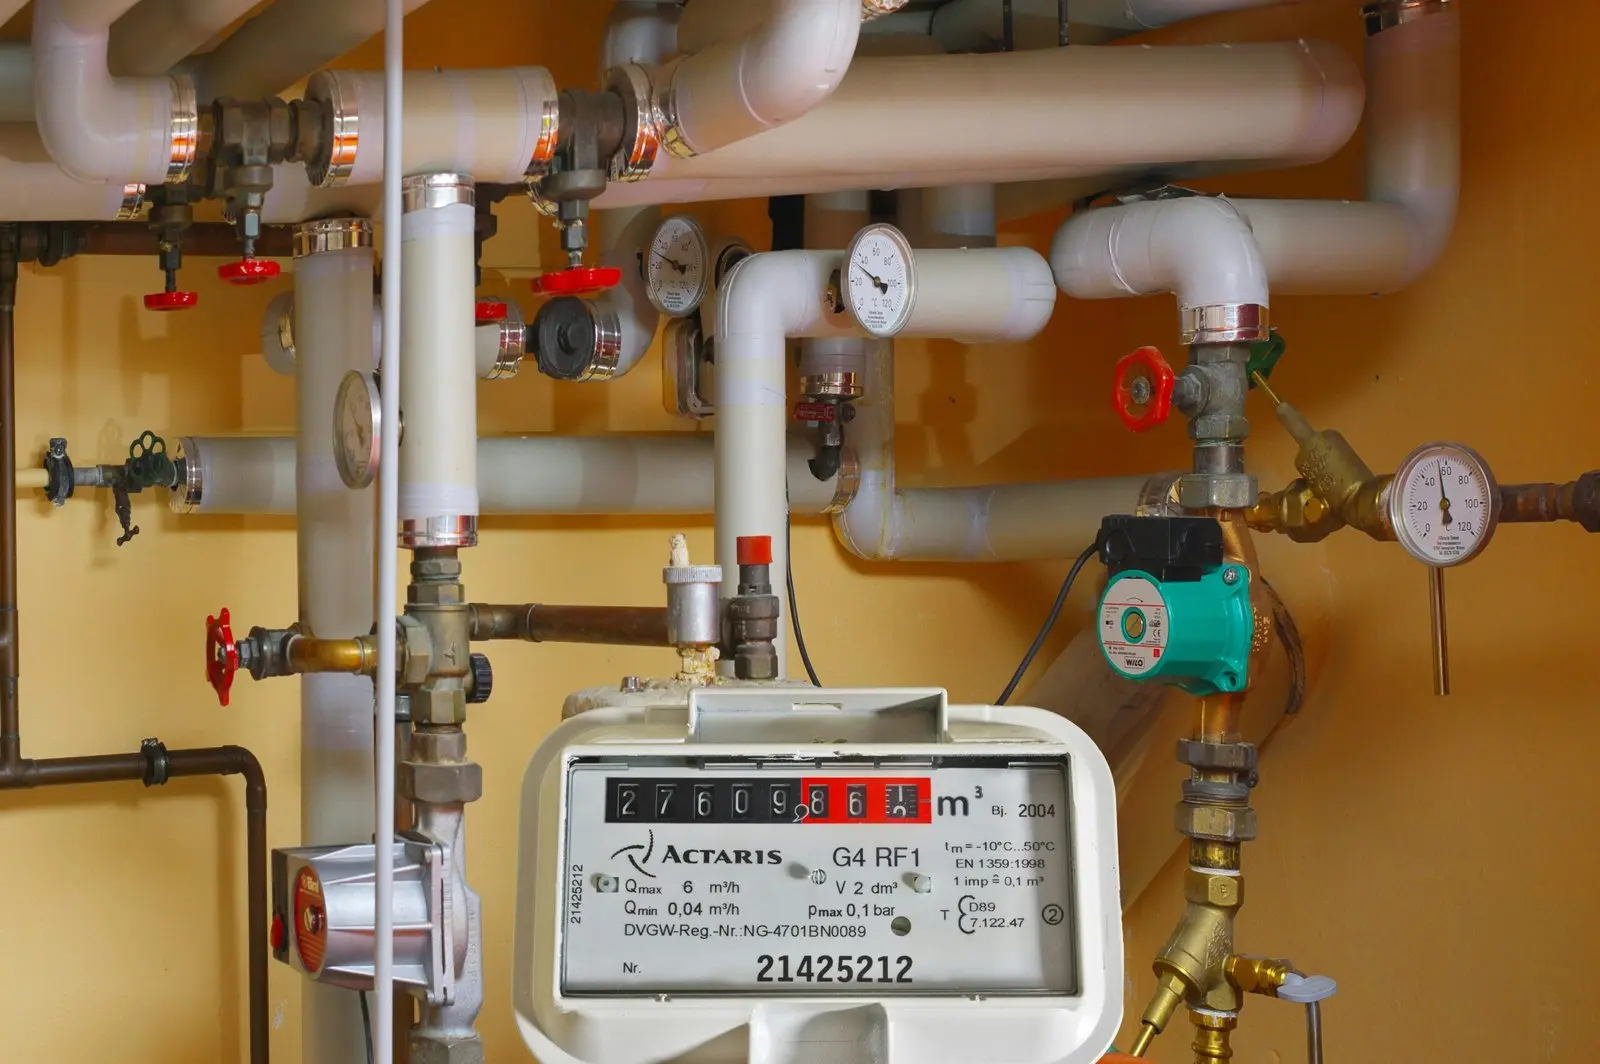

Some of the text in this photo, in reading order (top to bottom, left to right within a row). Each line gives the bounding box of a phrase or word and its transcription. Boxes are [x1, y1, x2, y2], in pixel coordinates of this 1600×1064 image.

[861, 256, 868, 264] 40
[856, 278, 862, 286] 20
[882, 299, 892, 308] 120
[1441, 466, 1452, 476] 60
[1424, 477, 1435, 486] 40
[1458, 476, 1469, 484] 80
[1417, 502, 1428, 510] 20
[1465, 499, 1478, 508] 100
[1425, 523, 1430, 532] 0
[1458, 522, 1472, 532] 120
[1125, 658, 1144, 667] WILO
[992, 804, 1056, 818] Bj. 2004
[662, 845, 782, 864] ACTARIS
[832, 847, 920, 867] G4 RF1
[956, 859, 1045, 868] EN 1359:1998
[625, 878, 740, 894] Qmax 6 m³/h
[836, 880, 898, 894] V 2 dm³
[964, 876, 988, 888] imp
[1004, 876, 1022, 886] 0,1
[570, 864, 584, 924] 21425212
[624, 900, 740, 918] Qmin 0,04 m³/h
[808, 904, 896, 919] pmax 0,1 bar
[969, 902, 996, 912] D89
[940, 910, 950, 920] T
[970, 918, 1025, 928] 7.122.47
[623, 962, 642, 974] Nr.
[756, 954, 913, 982] 21425212
